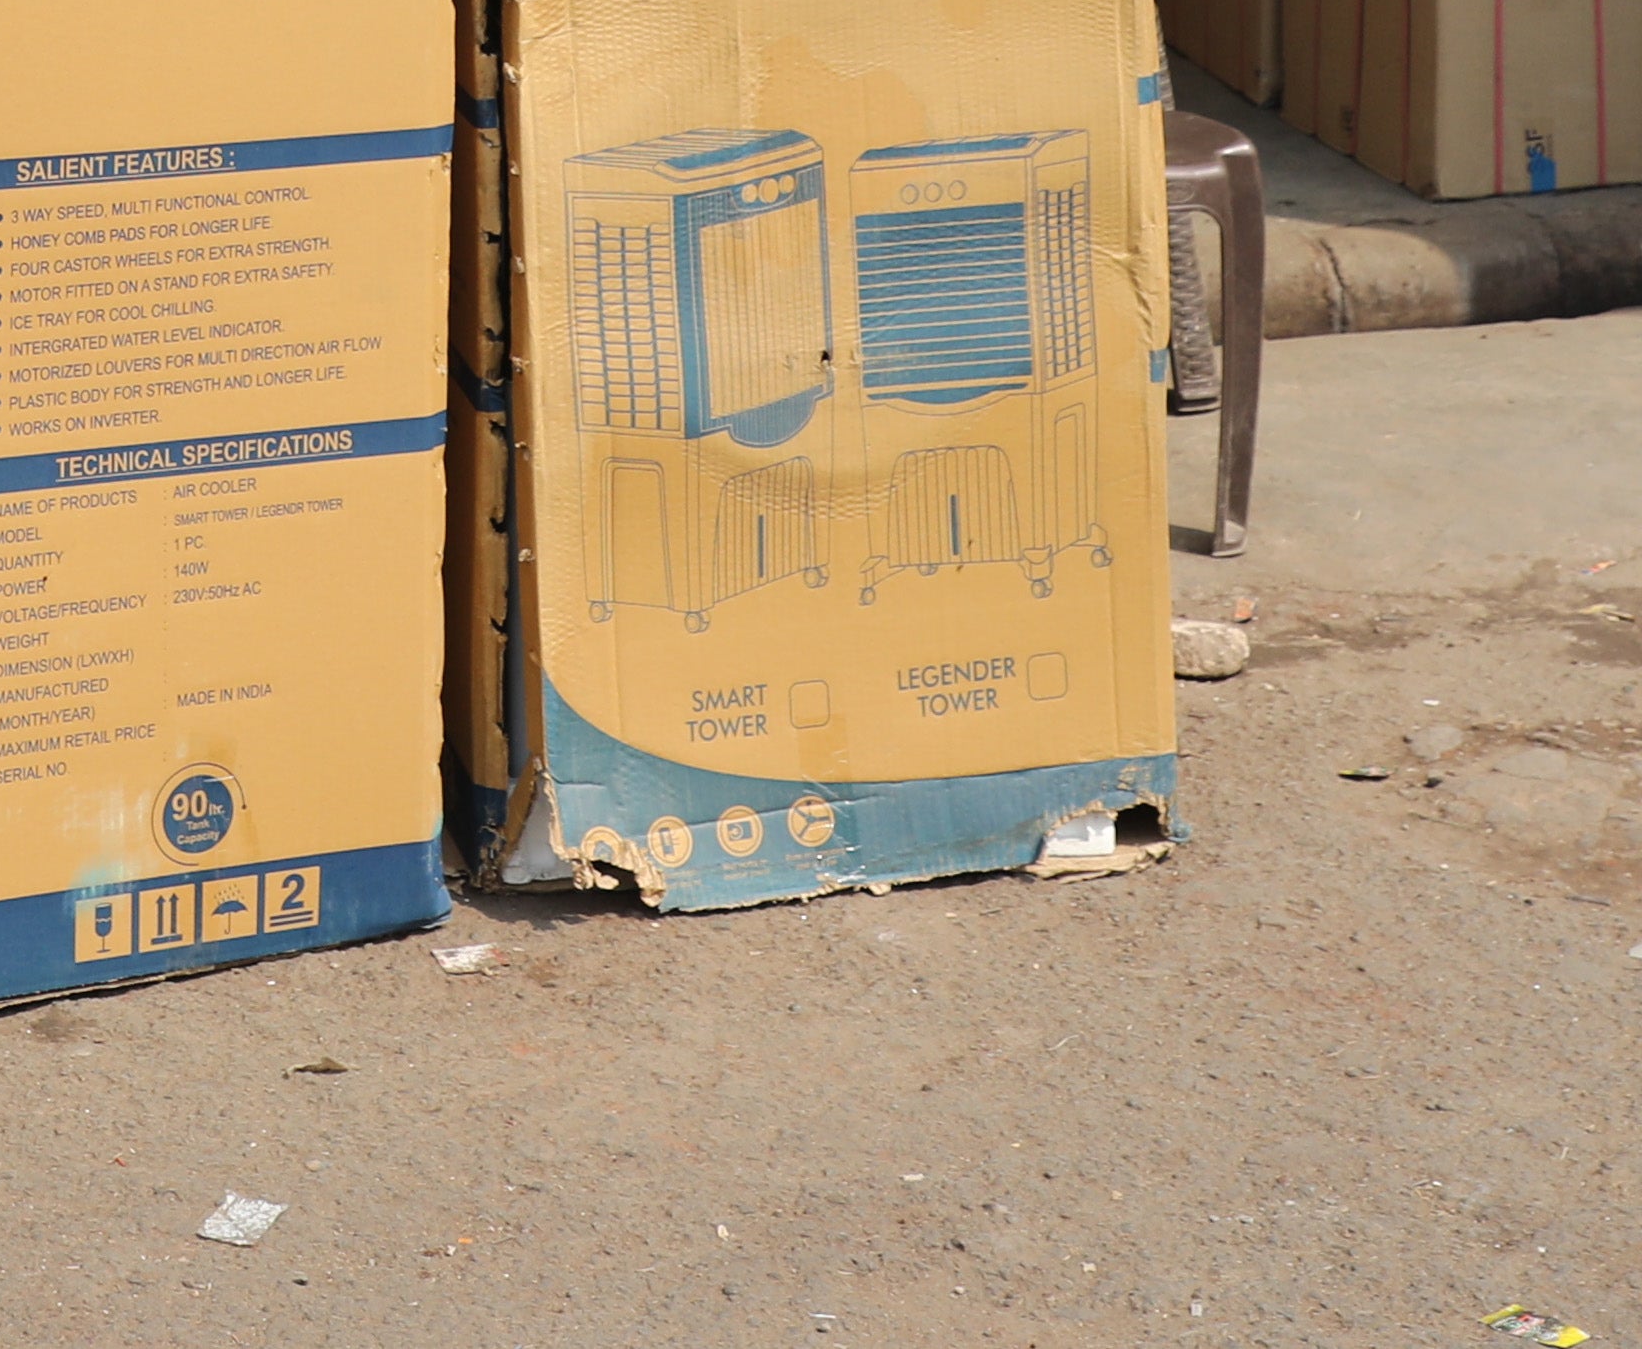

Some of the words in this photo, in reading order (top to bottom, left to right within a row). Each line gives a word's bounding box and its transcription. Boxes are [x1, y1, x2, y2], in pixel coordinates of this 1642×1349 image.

[16, 154, 108, 183] SALIENT
[113, 146, 224, 177] FEATURES
[12, 210, 18, 223] 3
[23, 208, 53, 222] WAY
[57, 204, 107, 220] SPEED,
[112, 200, 151, 215] MULTI
[156, 193, 240, 211] FUNCTIONAL
[11, 234, 60, 250] HONEY
[64, 230, 105, 246] COMB
[110, 226, 145, 241] PADS
[150, 223, 179, 238] FOR
[181, 219, 238, 237] LONGER
[11, 261, 49, 277] FOUR
[54, 256, 112, 273] CASTOR
[115, 251, 172, 269] WHEELS
[177, 248, 206, 262] FOR
[209, 244, 254, 260] EXTRA
[257, 237, 332, 256] STRENGTH.
[10, 286, 61, 302] MOTOR
[66, 282, 114, 298] FITTED
[118, 280, 138, 294] ON
[141, 279, 151, 292] A
[153, 275, 199, 292] STAND
[203, 272, 230, 286] FOR
[235, 268, 280, 284] EXTRA
[10, 315, 32, 329] ICE
[37, 312, 72, 326] TRAY
[77, 309, 106, 323] FOR
[108, 306, 147, 321] COOL
[10, 335, 107, 356] INTERGRATED
[110, 331, 159, 348] WATER
[164, 327, 206, 342] LEVEL
[10, 363, 92, 382] MOTORIZED
[97, 357, 161, 375] LOUVERS
[166, 353, 194, 368] FOR
[198, 350, 237, 365] MULTI
[240, 343, 315, 362] DIRECTION
[318, 340, 339, 355] AIR
[344, 337, 381, 351] FLOW
[10, 392, 66, 409] PLASTIC
[71, 388, 109, 404] BODY
[114, 385, 143, 399] FOR
[145, 378, 222, 397] STRENGTH
[224, 374, 252, 389] AND
[257, 369, 312, 386] LONGER
[9, 419, 62, 436] WORKS
[65, 417, 85, 431] ON
[90, 410, 162, 428] INVERTER.
[57, 447, 178, 479] TECHNICAL
[182, 428, 353, 468] SPECIFICATIONS
[37, 498, 56, 513] OF
[61, 490, 137, 510] PRODUCTS
[173, 484, 197, 498] AIR
[199, 478, 257, 496] COOLER
[174, 511, 210, 526] SMART
[212, 507, 249, 522] TOWER
[257, 502, 305, 519] LEGENDR
[306, 498, 343, 513] TOWER
[175, 561, 208, 577] 140W
[242, 581, 261, 596] AC
[77, 649, 134, 670] (LXWXH)
[897, 656, 1017, 692] LEGENDER
[177, 690, 215, 707] MADE
[220, 688, 233, 701] IN
[238, 684, 272, 699] INDIA
[691, 683, 767, 713] SMART
[917, 688, 999, 718] TOWER
[65, 731, 112, 747] RETAIL
[114, 724, 155, 741] PRICE
[686, 713, 768, 743] TOWER
[173, 790, 208, 821] 90
[177, 830, 220, 845] Capacity
[281, 873, 306, 909] 2
